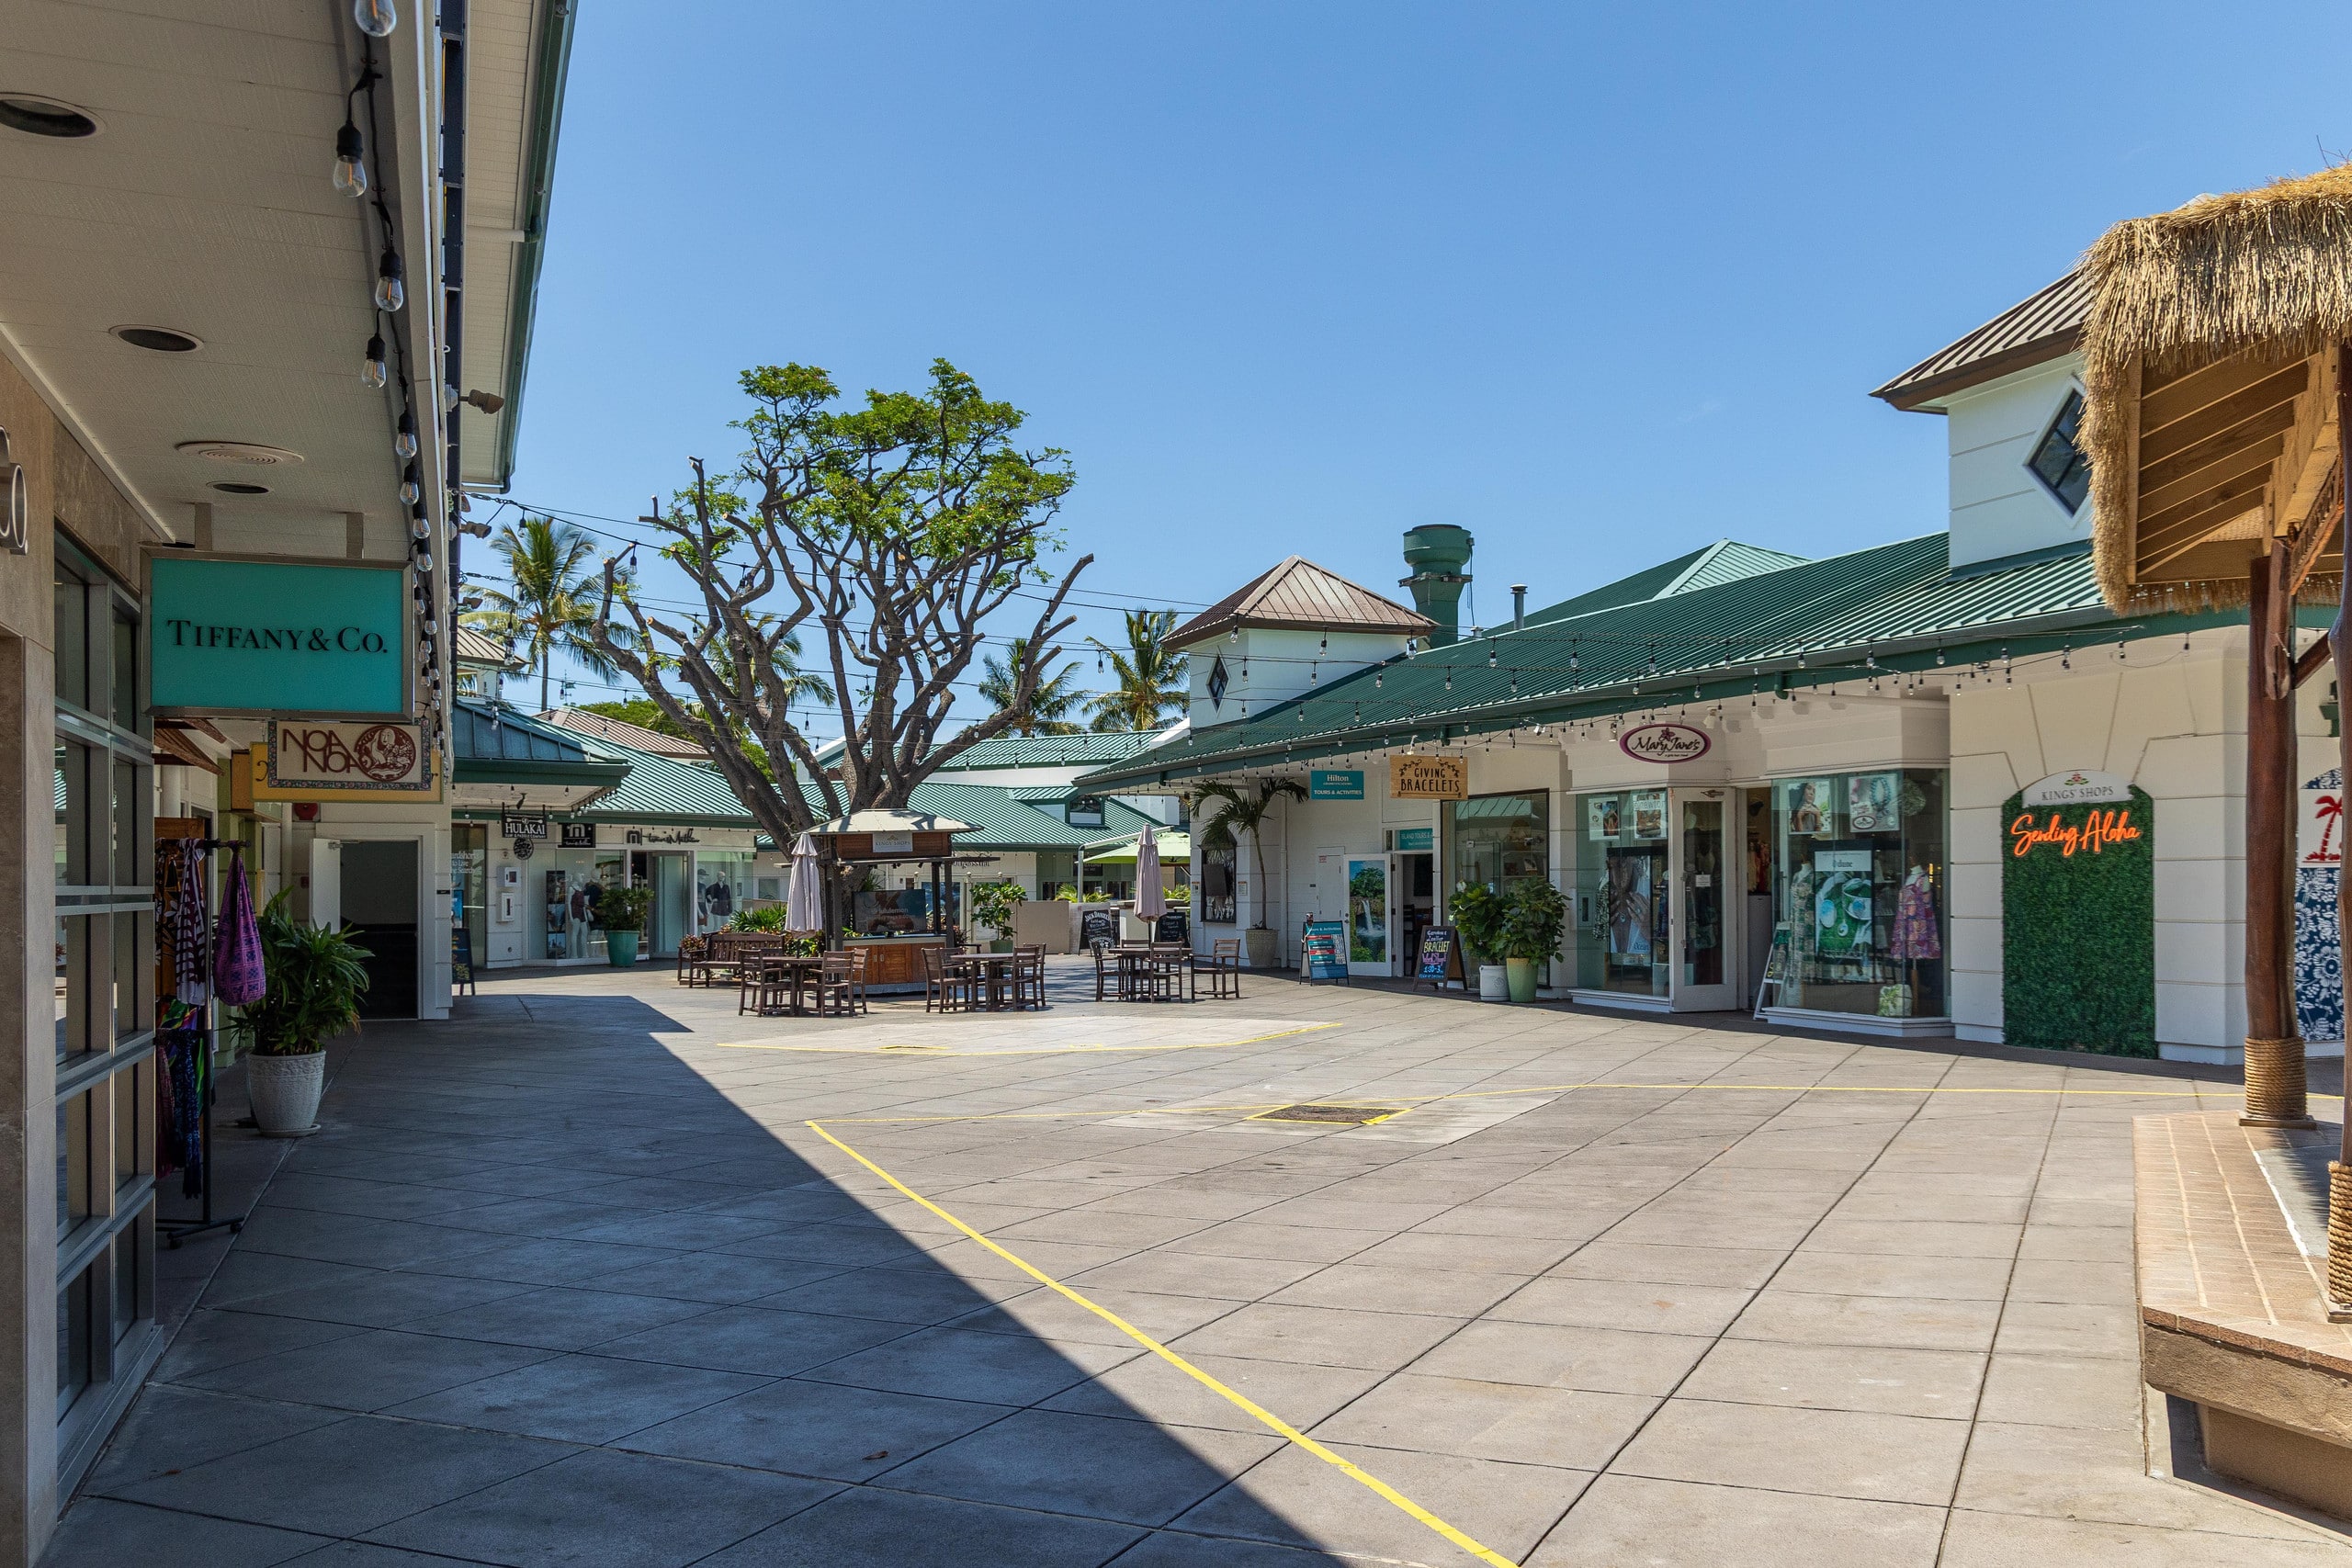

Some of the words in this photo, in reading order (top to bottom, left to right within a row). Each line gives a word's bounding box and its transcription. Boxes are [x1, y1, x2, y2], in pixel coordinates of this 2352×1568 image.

[167, 619, 303, 651] TIFFANY
[308, 627, 331, 651] &
[282, 728, 353, 752] NOA
[1632, 736, 1668, 756] Mary
[303, 750, 364, 773] NOA
[1414, 768, 1445, 779] GIVING
[1400, 779, 1460, 792] BRACELETS
[2079, 785, 2114, 797] SHOPS
[505, 823, 546, 835] HULAKAI
[2010, 812, 2079, 858] Sending
[2079, 809, 2142, 854] Aloha
[1424, 941, 1450, 953] BRACELET
